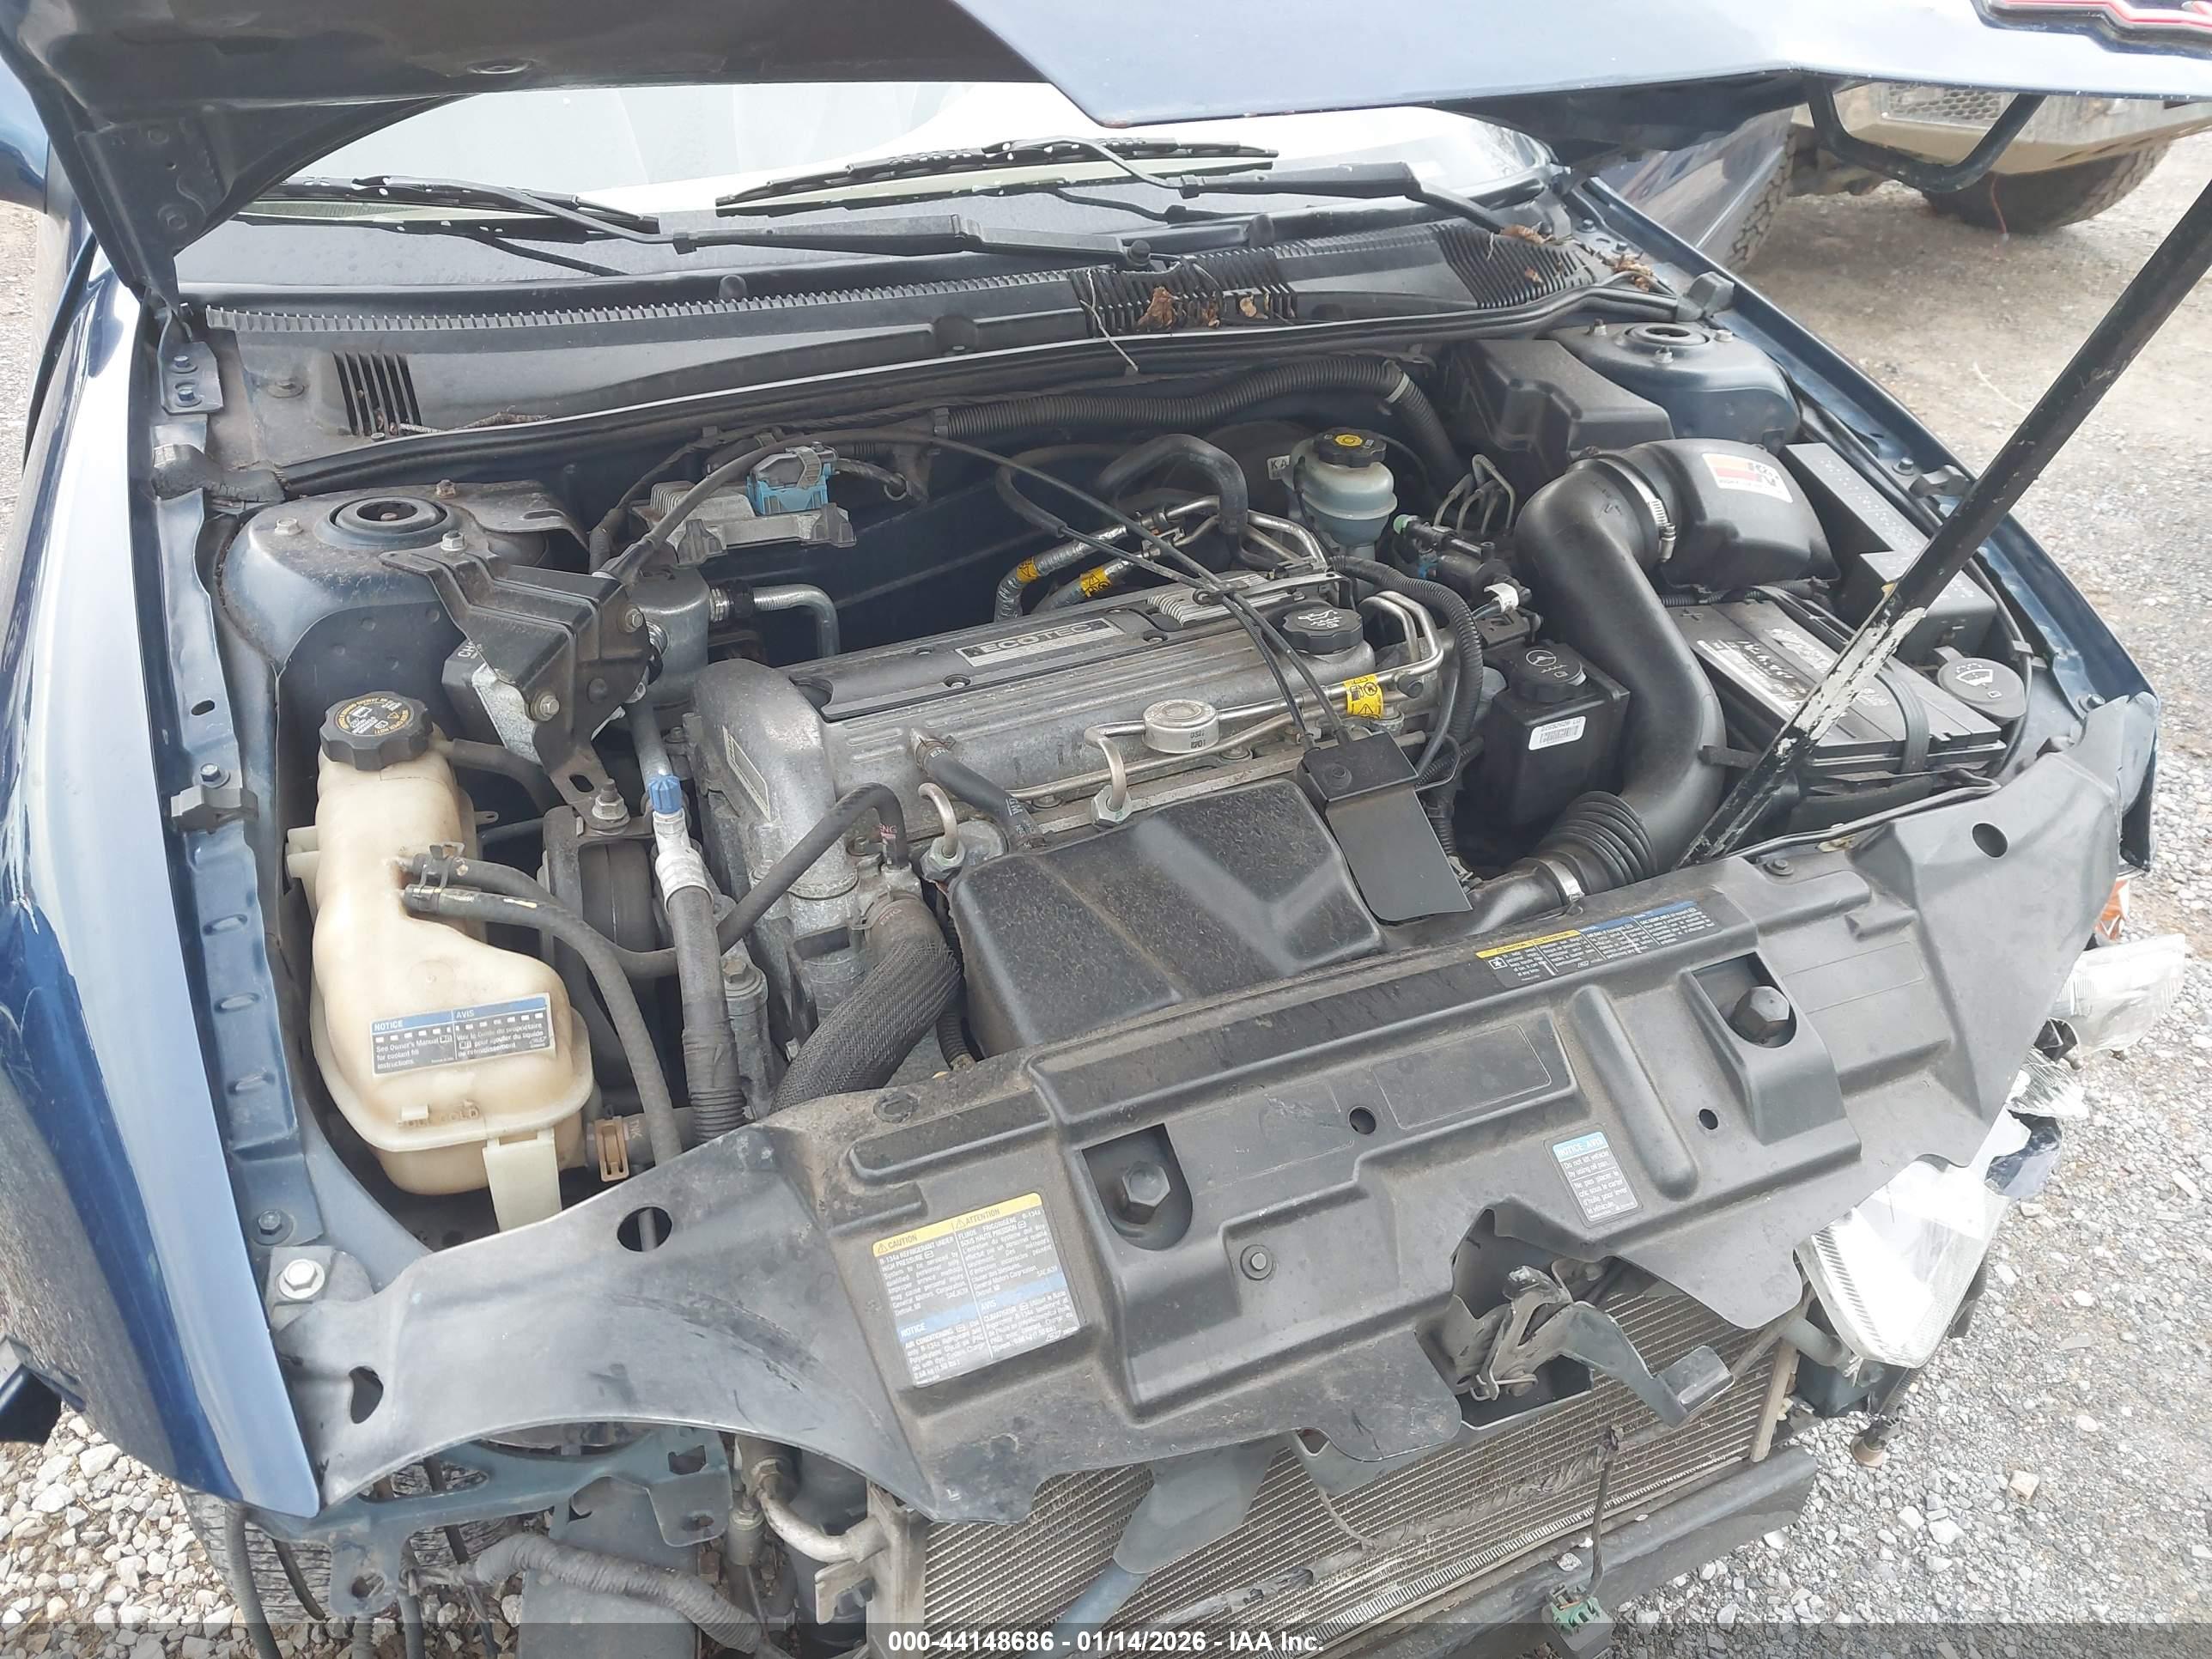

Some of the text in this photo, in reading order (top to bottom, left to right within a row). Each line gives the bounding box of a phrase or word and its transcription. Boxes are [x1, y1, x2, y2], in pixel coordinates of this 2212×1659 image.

[981, 623, 1091, 653] ECOTEC
[1010, 799, 1024, 816] GM
[456, 1010, 474, 1018] AVIS
[374, 1020, 403, 1031] NOTICE
[523, 1030, 544, 1040] liquide
[390, 1041, 415, 1051] Owner's
[416, 1037, 439, 1047] Manual
[387, 1050, 410, 1060] coolant
[964, 1208, 1000, 1224] ATTENTION
[888, 1235, 917, 1249] CAUTION
[960, 1224, 1018, 1248] SOUS HAUTE PRESSION
[899, 1243, 935, 1259] REFRIGERANT
[934, 1237, 954, 1247] UNDER
[882, 1254, 924, 1273] HIGH PRESSURE
[980, 1299, 997, 1311] AVIS
[900, 1322, 928, 1338] NOTICE
[915, 1328, 953, 1346] CONDITIONING
